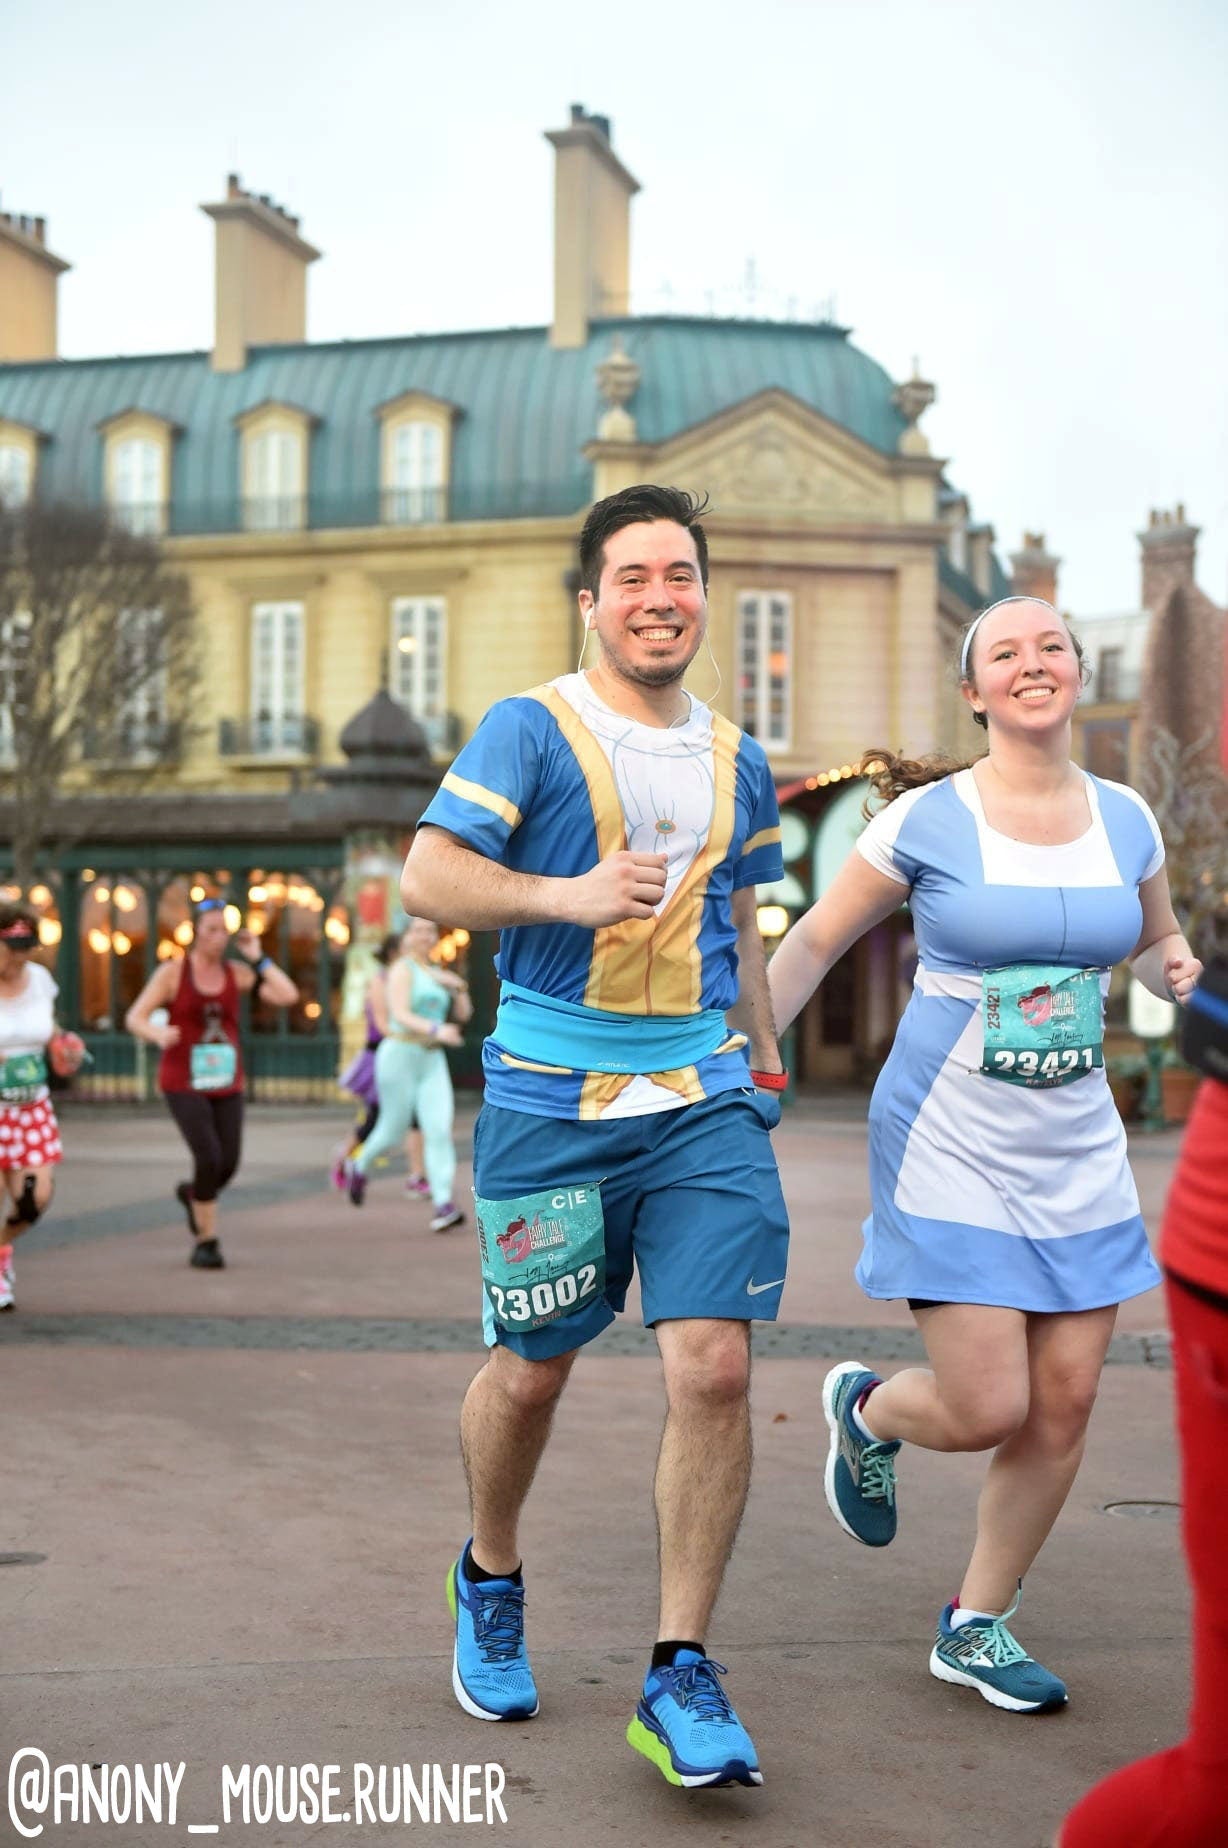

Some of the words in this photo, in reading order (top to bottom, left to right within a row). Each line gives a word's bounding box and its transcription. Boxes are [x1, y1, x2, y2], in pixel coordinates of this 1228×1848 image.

[987, 987, 1001, 1030] 23421
[994, 1048, 1093, 1079] 23421
[528, 1222, 547, 1242] FAIRY
[547, 1218, 565, 1237] TALE
[530, 1233, 566, 1250] CHALLENGE
[490, 1264, 597, 1322] 23002
[532, 1310, 561, 1327] KEVIN
